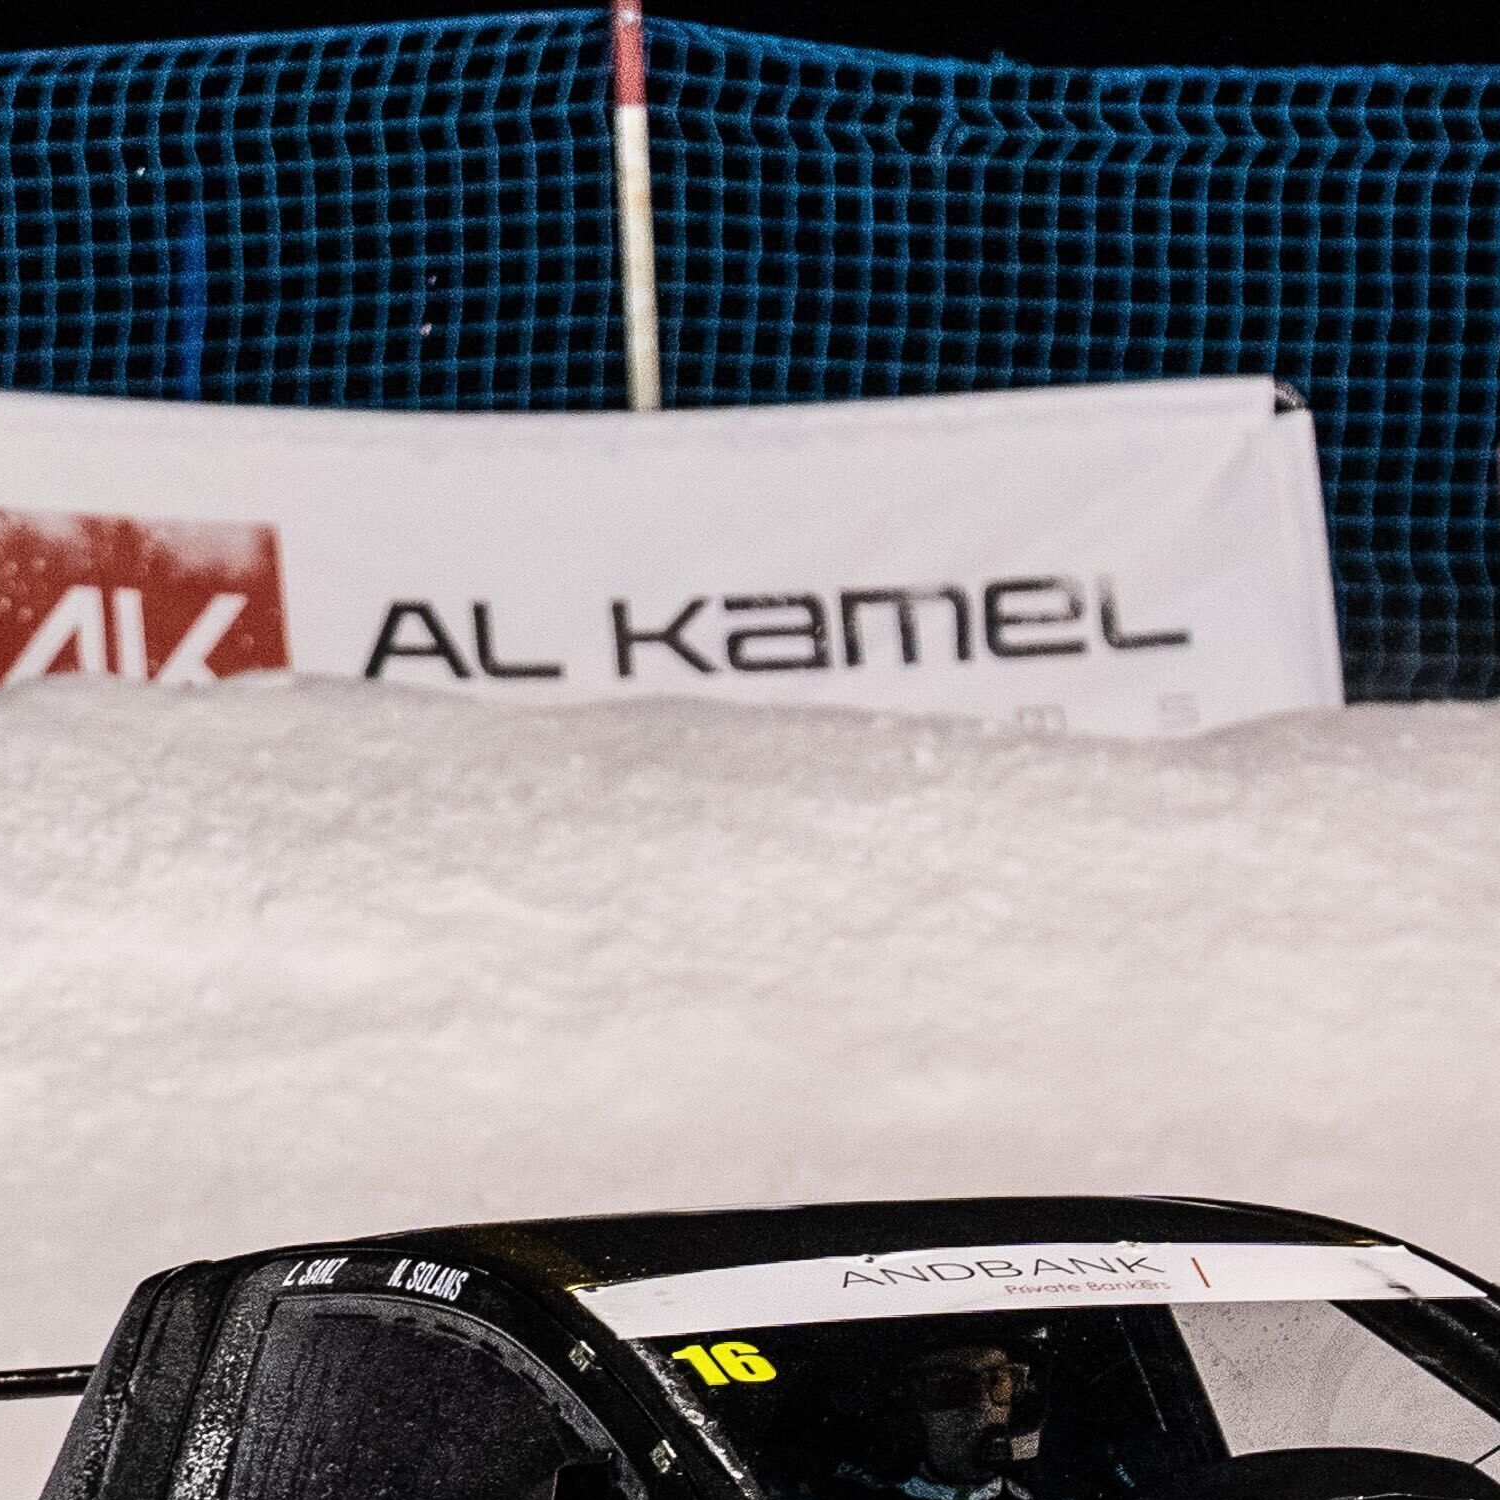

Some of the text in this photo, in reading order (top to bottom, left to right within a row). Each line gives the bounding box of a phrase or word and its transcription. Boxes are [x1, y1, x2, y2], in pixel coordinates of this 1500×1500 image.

[362, 599, 564, 679] AL
[297, 1257, 349, 1287] SANZ
[405, 1261, 470, 1302] SOLANS
[842, 1256, 1166, 1289] ANDBANK
[673, 1341, 778, 1387] 16
